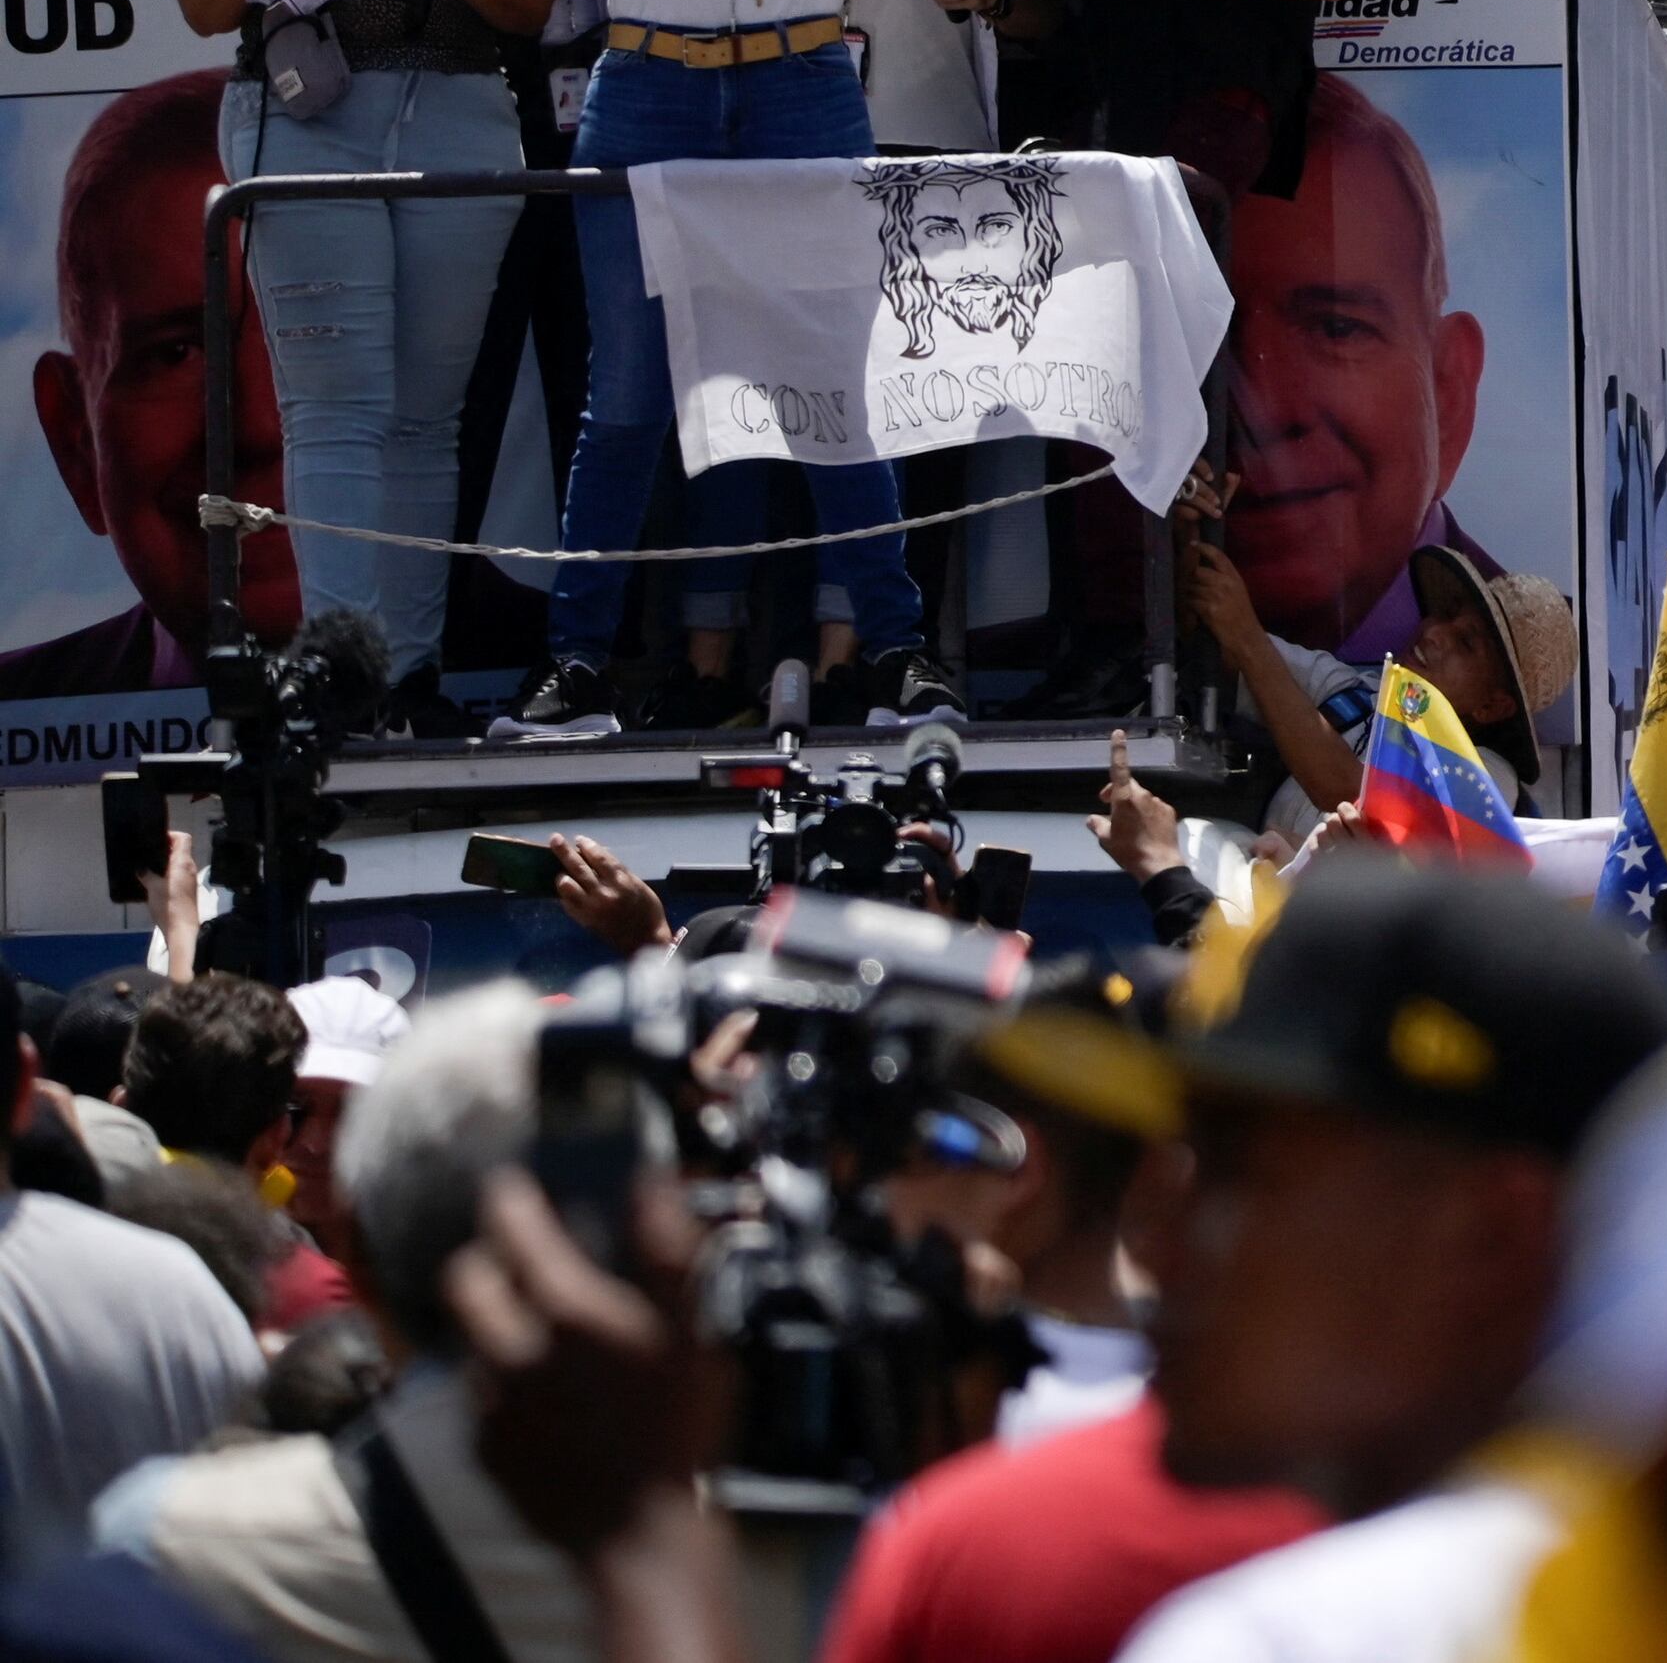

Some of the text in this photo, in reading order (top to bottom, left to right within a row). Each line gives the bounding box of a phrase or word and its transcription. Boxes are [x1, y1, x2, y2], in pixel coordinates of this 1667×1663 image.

[1338, 39, 1515, 63] Democrática
[731, 362, 1141, 444] CON NOSOTRO
